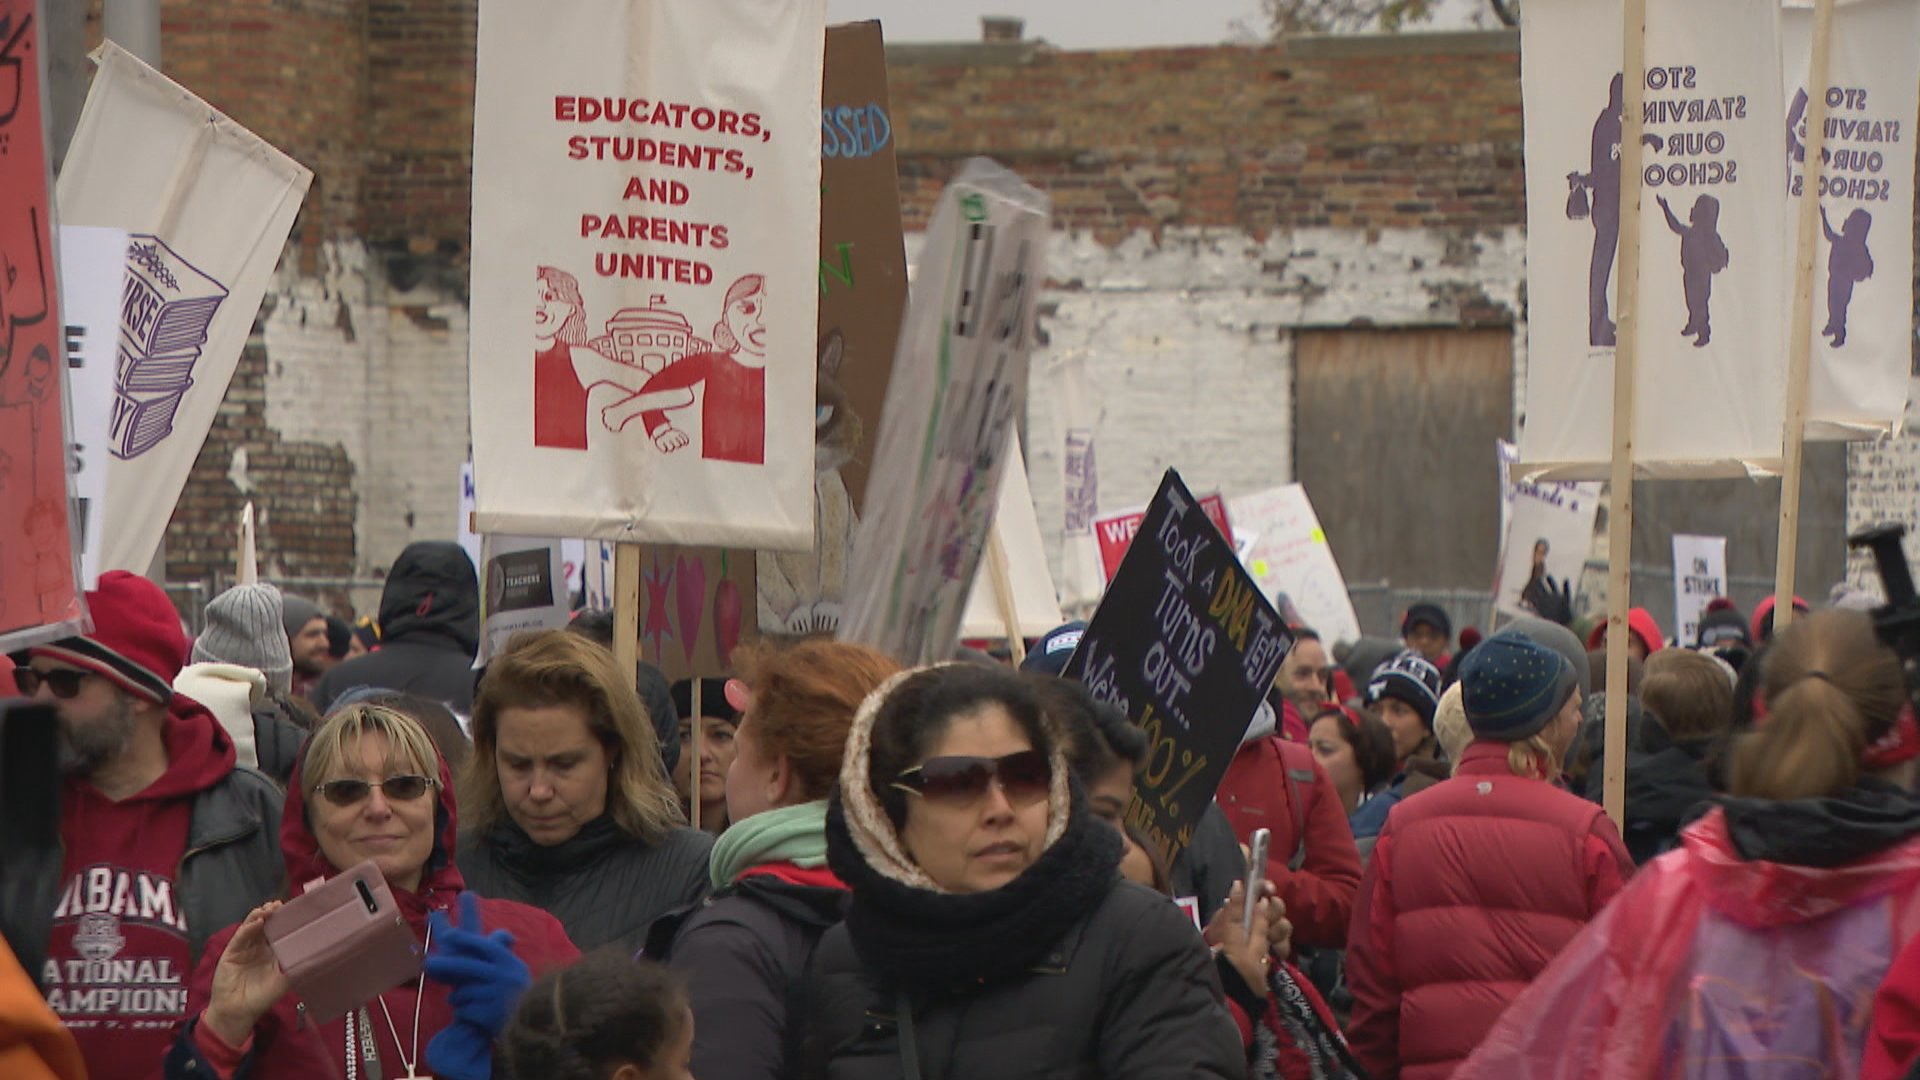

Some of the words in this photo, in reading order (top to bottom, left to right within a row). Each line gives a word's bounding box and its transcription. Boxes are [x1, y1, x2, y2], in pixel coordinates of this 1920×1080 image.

[554, 95, 772, 143] EDUCATORS,
[822, 102, 891, 158] SSED
[567, 135, 755, 180] STUDENTS,
[622, 175, 690, 206] AND
[580, 213, 730, 249] PARENTS
[595, 252, 713, 285] UNITED
[1201, 569, 1215, 595] A
[1208, 566, 1254, 653] DNA
[54, 867, 188, 932] ABAM
[42, 959, 182, 984] ATIONAL
[47, 988, 188, 1014] AMPION
